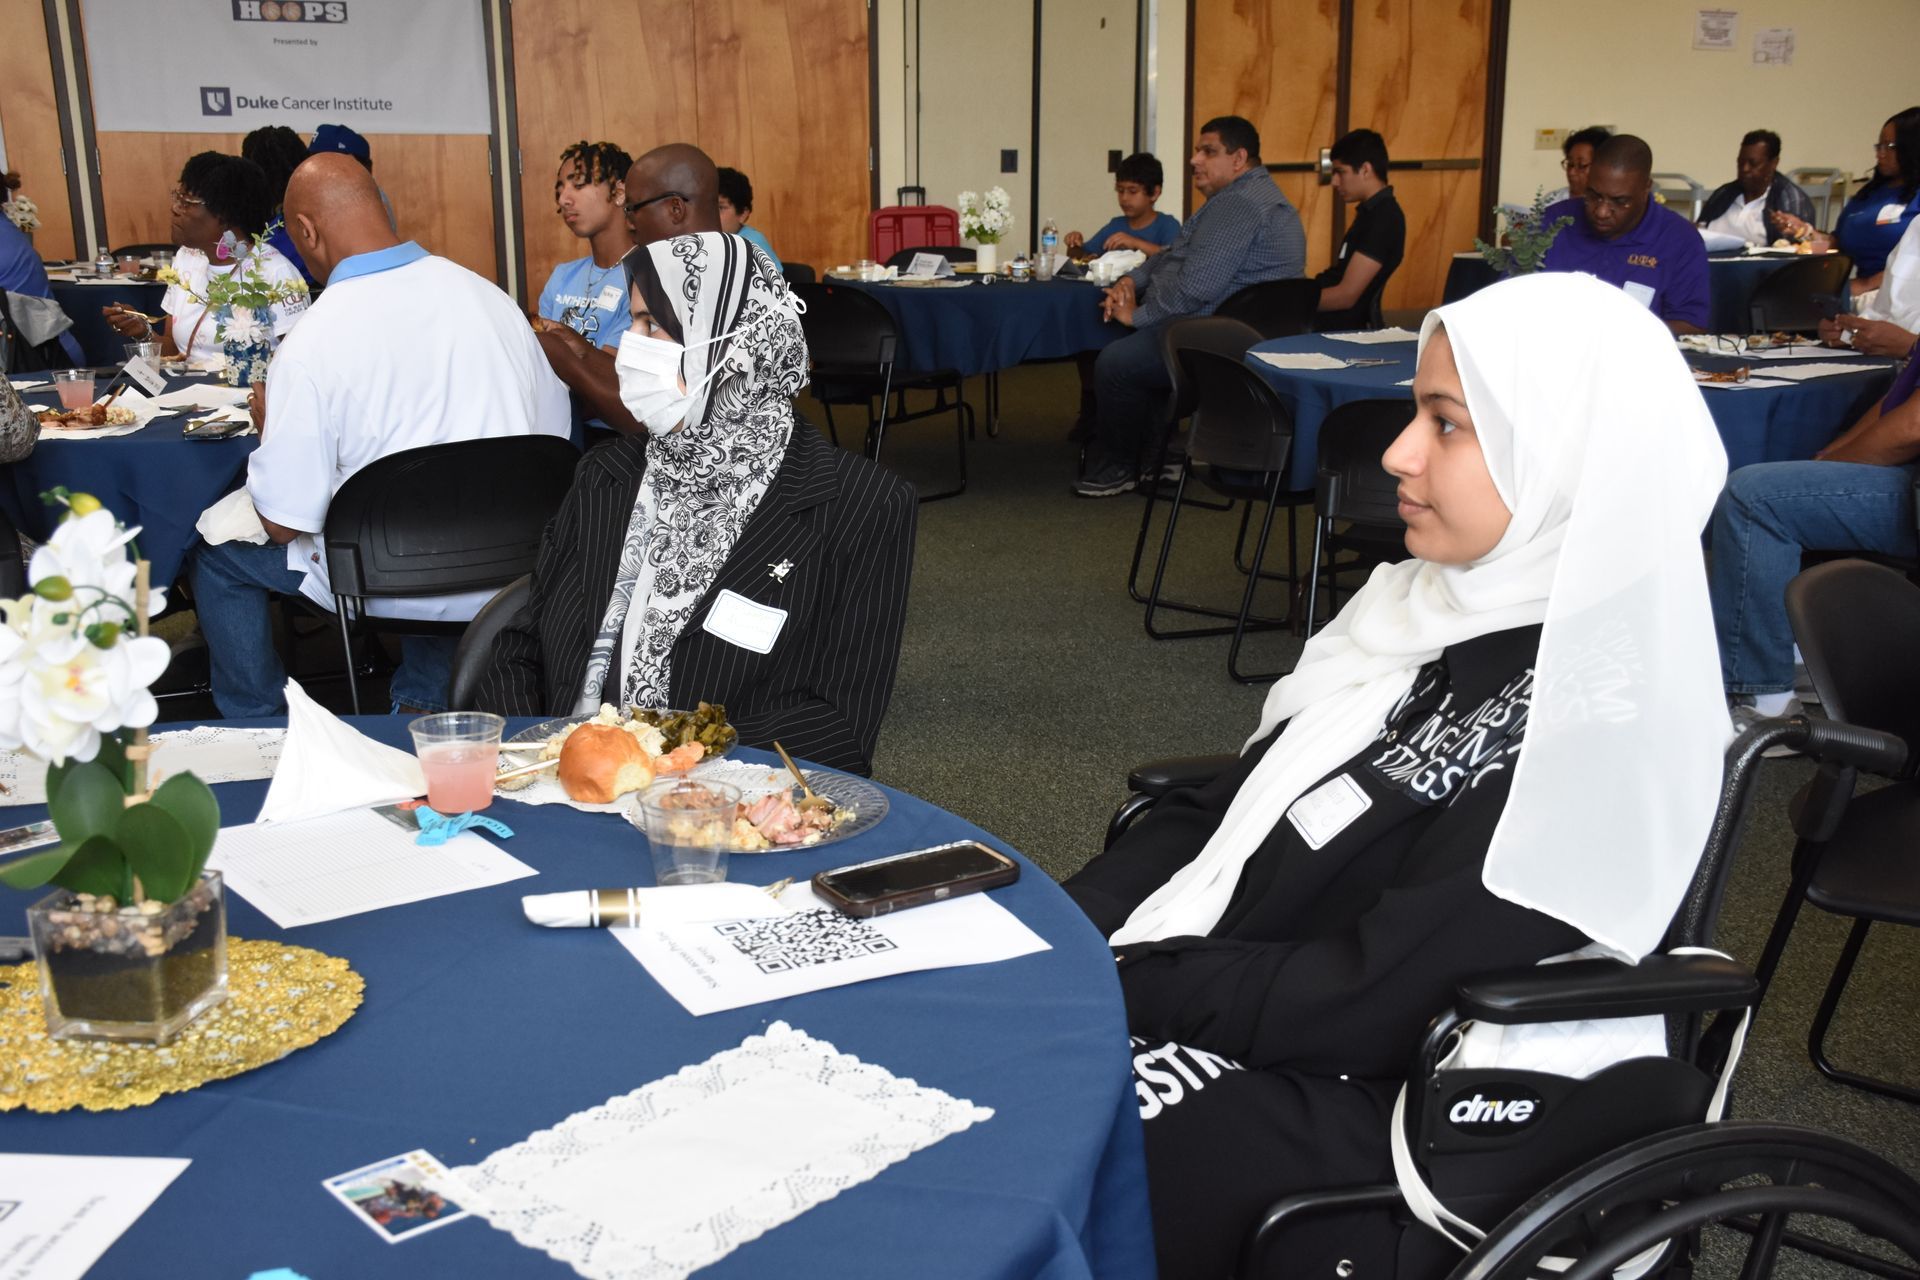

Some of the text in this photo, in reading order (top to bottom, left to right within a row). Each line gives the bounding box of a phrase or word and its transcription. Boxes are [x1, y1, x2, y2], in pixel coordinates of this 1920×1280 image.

[239, 0, 346, 21] HOOPS
[273, 37, 318, 46] Presented by
[236, 95, 393, 111] Duke Cancer Institute
[1449, 1094, 1534, 1123] drive
